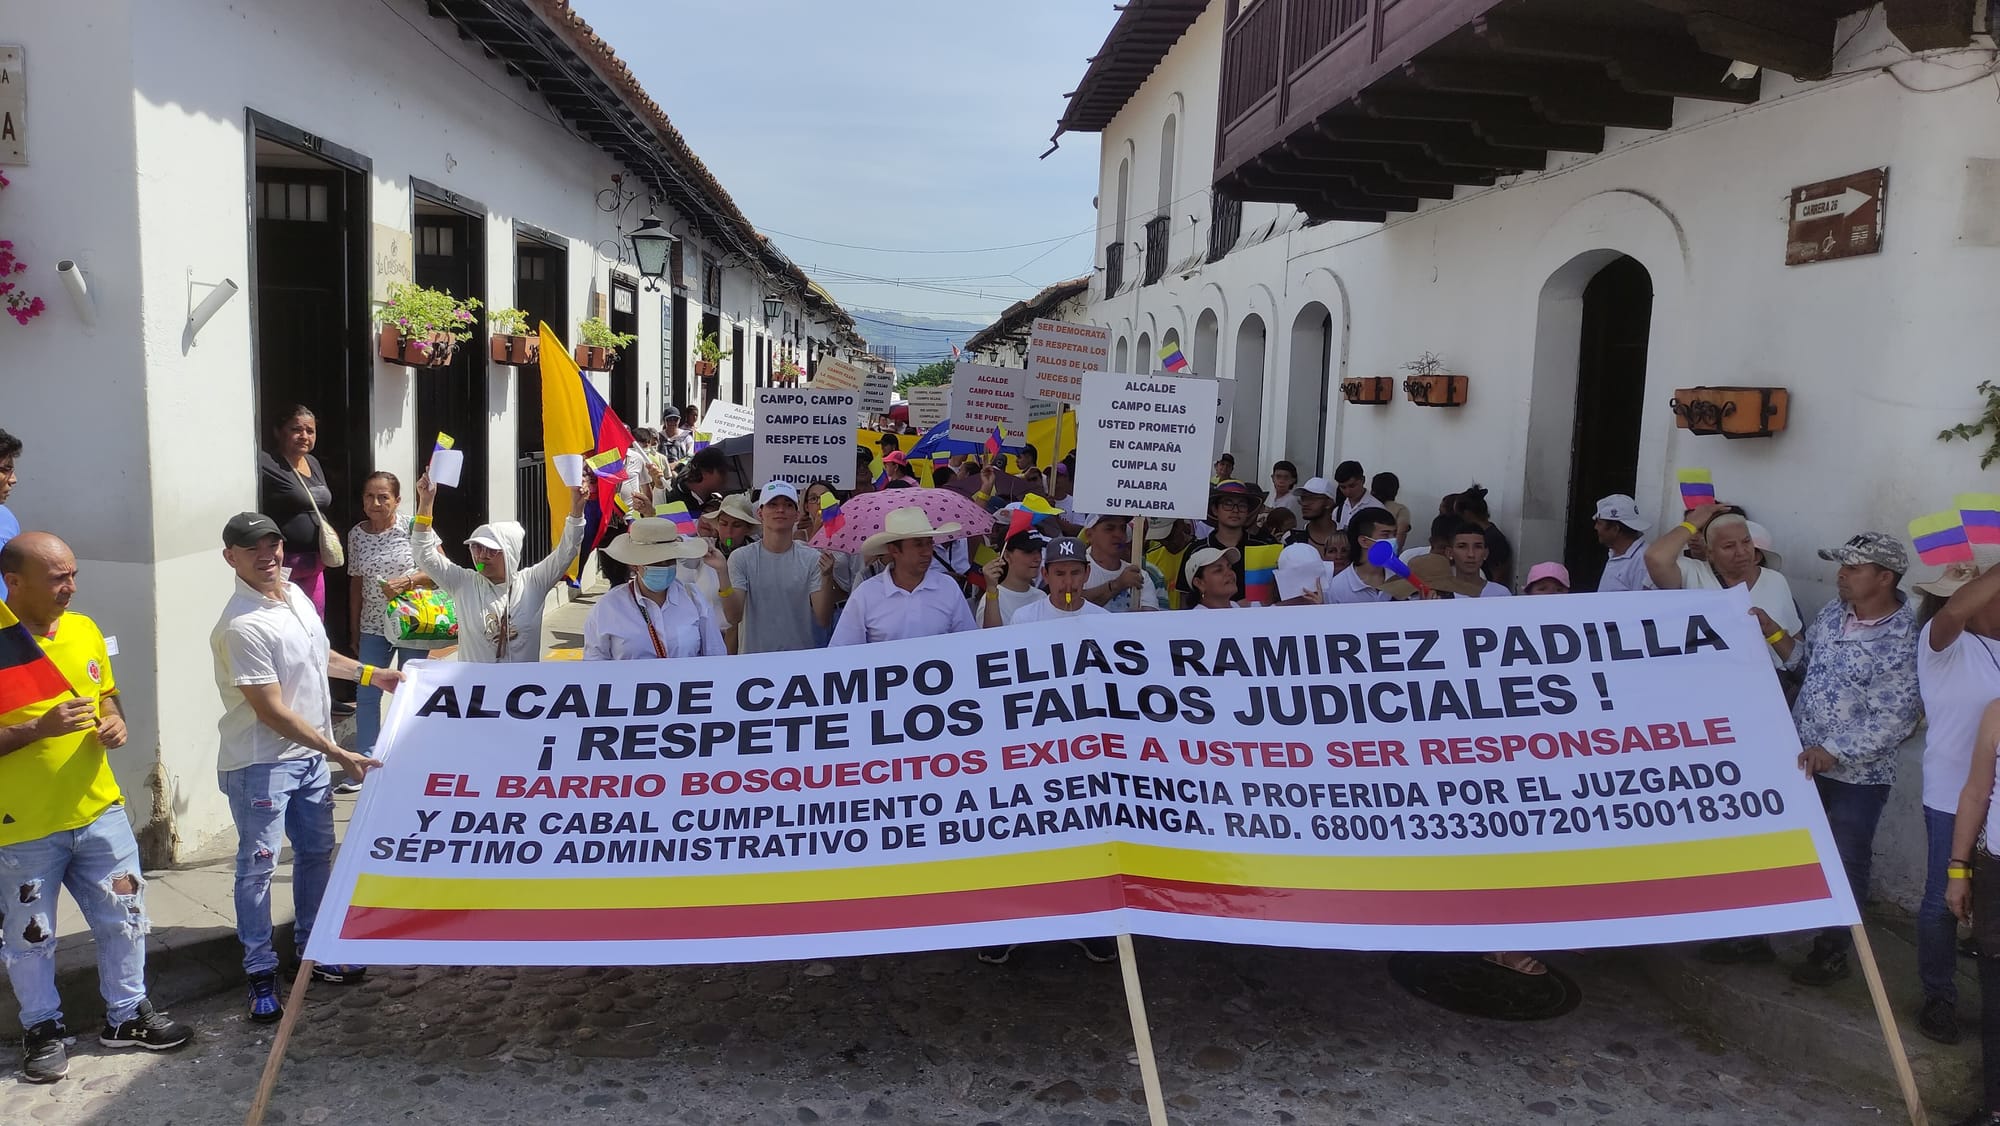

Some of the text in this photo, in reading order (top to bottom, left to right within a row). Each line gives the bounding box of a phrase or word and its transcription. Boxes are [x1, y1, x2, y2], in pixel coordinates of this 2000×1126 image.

[1803, 200, 1838, 217] CARRERA 26
[1037, 323, 1106, 339] SER DEMOCRATA
[1032, 338, 1106, 356] ES RESPETAR LOS
[1036, 355, 1098, 371] FALLOS DE LOS
[978, 375, 1008, 384] ALCALDE
[1035, 372, 1081, 385] JUECES DE
[969, 387, 1015, 398] CAMPO ELIAS
[1125, 381, 1176, 394] ALCALDE
[760, 394, 853, 406] CAMPO, CAMPO
[1039, 388, 1080, 401] REPUBLIC
[1111, 400, 1186, 414] CAMPO ELIAS
[724, 413, 746, 423] CAMPO
[765, 414, 812, 425] CAMPO
[813, 413, 847, 425] ELÍAS
[951, 424, 1024, 437] PAGUE LA SENCIA
[1098, 419, 1196, 434] USTED PROMETIÓ
[765, 434, 846, 445] RESPETE LOS
[1109, 440, 1182, 453] EN CAMPAÑA
[783, 455, 828, 464] FALLOS
[1111, 459, 1176, 472] CUMPLA SU
[770, 474, 840, 484] JUDICIALES
[1117, 479, 1168, 491] PALABRA
[1106, 498, 1175, 511] SU PALABRA
[415, 615, 1730, 720] ALCALDE CAMPO ELIAS RAMIREZ PADILLA
[537, 672, 1614, 771] ¡ RESPETE LOS FALLOS JUDICIALES !
[423, 717, 1736, 798] EL BARRIO BOSQUECITOS EXIGE A USTED SER RESPONSABLE
[415, 760, 1742, 835] Y DAR CABAL CUMPLIMIENTO A LA SENTENCIA PROFERIDA POR EL JUZGADO
[369, 788, 1785, 864] SÉPTIMO ADMINISTRATIVO DE BUCARAMANGA. RAD. 68001333300720150018300
